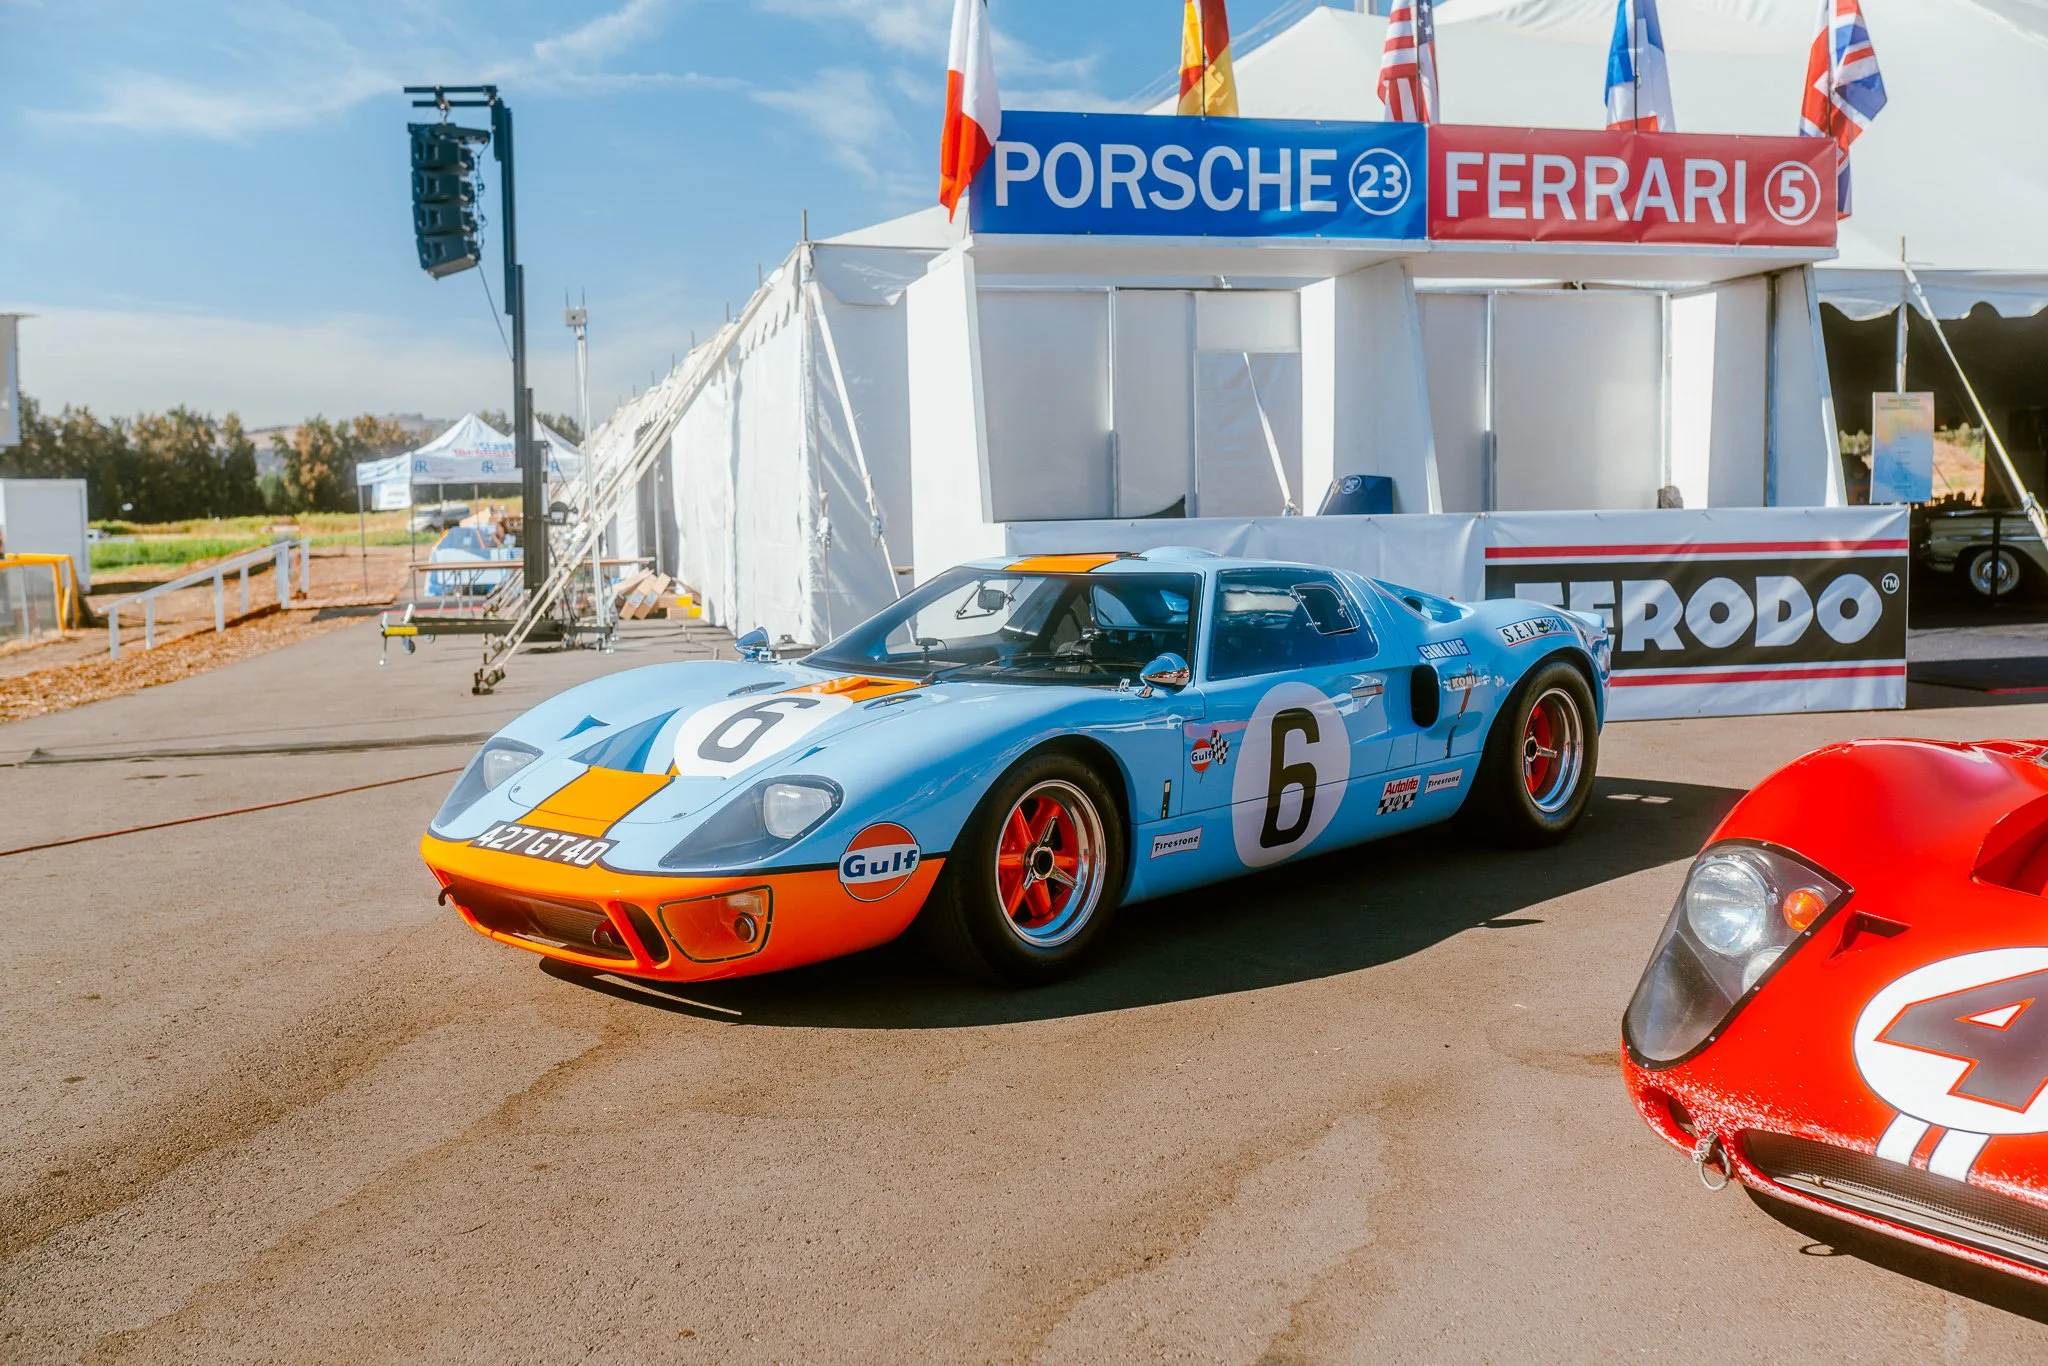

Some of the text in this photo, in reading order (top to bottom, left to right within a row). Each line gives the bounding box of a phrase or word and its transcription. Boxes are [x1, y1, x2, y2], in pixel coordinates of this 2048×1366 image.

[995, 141, 1402, 212] PORSCHE 23
[1445, 151, 1805, 225] FERRARI 5
[1418, 639, 1469, 659] GIRLING
[1451, 675, 1477, 688] KONI
[697, 697, 821, 763] 6
[1191, 750, 1213, 762] Gulf
[1259, 707, 1321, 849] 6
[1384, 778, 1419, 796] Autolite
[1427, 775, 1460, 789] Firestone
[476, 824, 611, 866] 427 GT40
[1154, 835, 1199, 852] Firestone
[843, 849, 918, 878] Gulf
[1876, 967, 2048, 1114] 4
